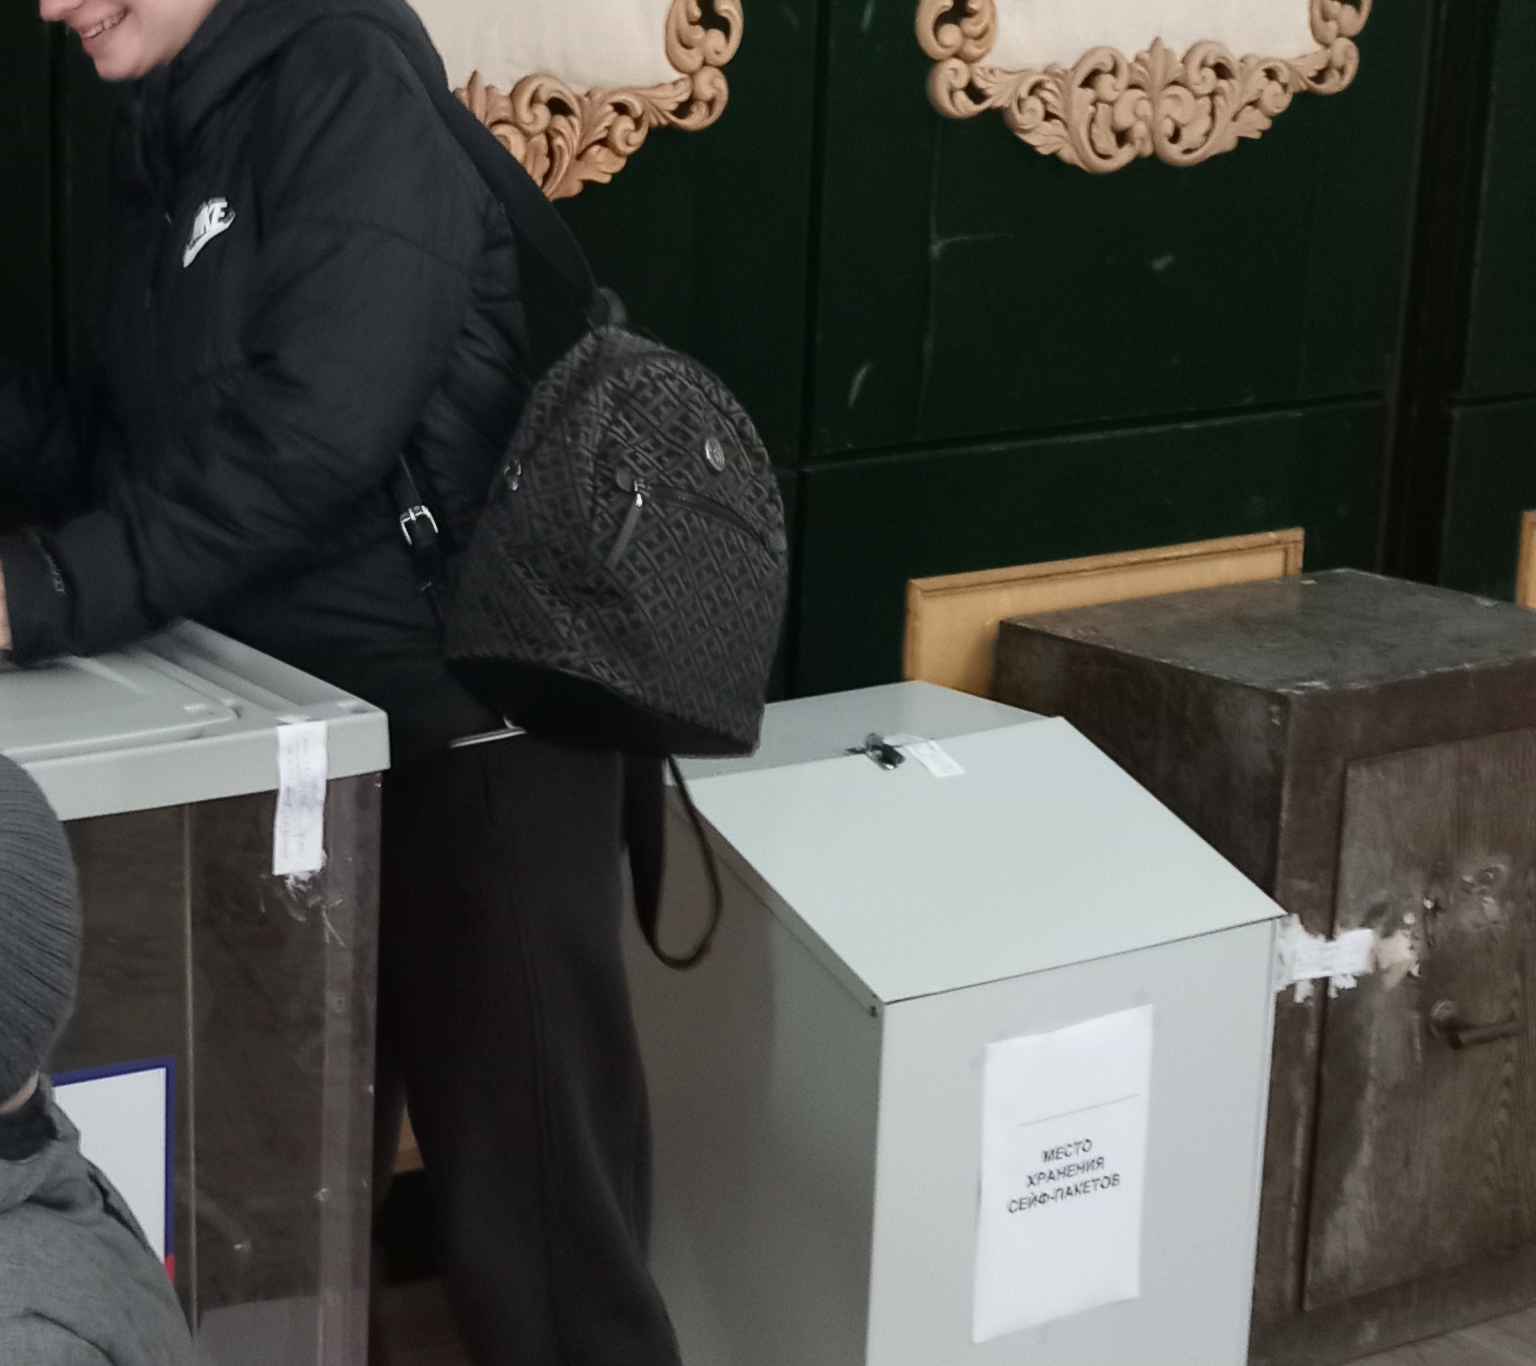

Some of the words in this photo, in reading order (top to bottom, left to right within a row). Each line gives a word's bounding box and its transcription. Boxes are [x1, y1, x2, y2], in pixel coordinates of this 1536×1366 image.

[1042, 1138, 1093, 1163] МЕСТО
[1026, 1155, 1105, 1189] ХРАНЕНИЯ
[1008, 1173, 1120, 1214] СЕЙФ-ПАКЕТОВ
